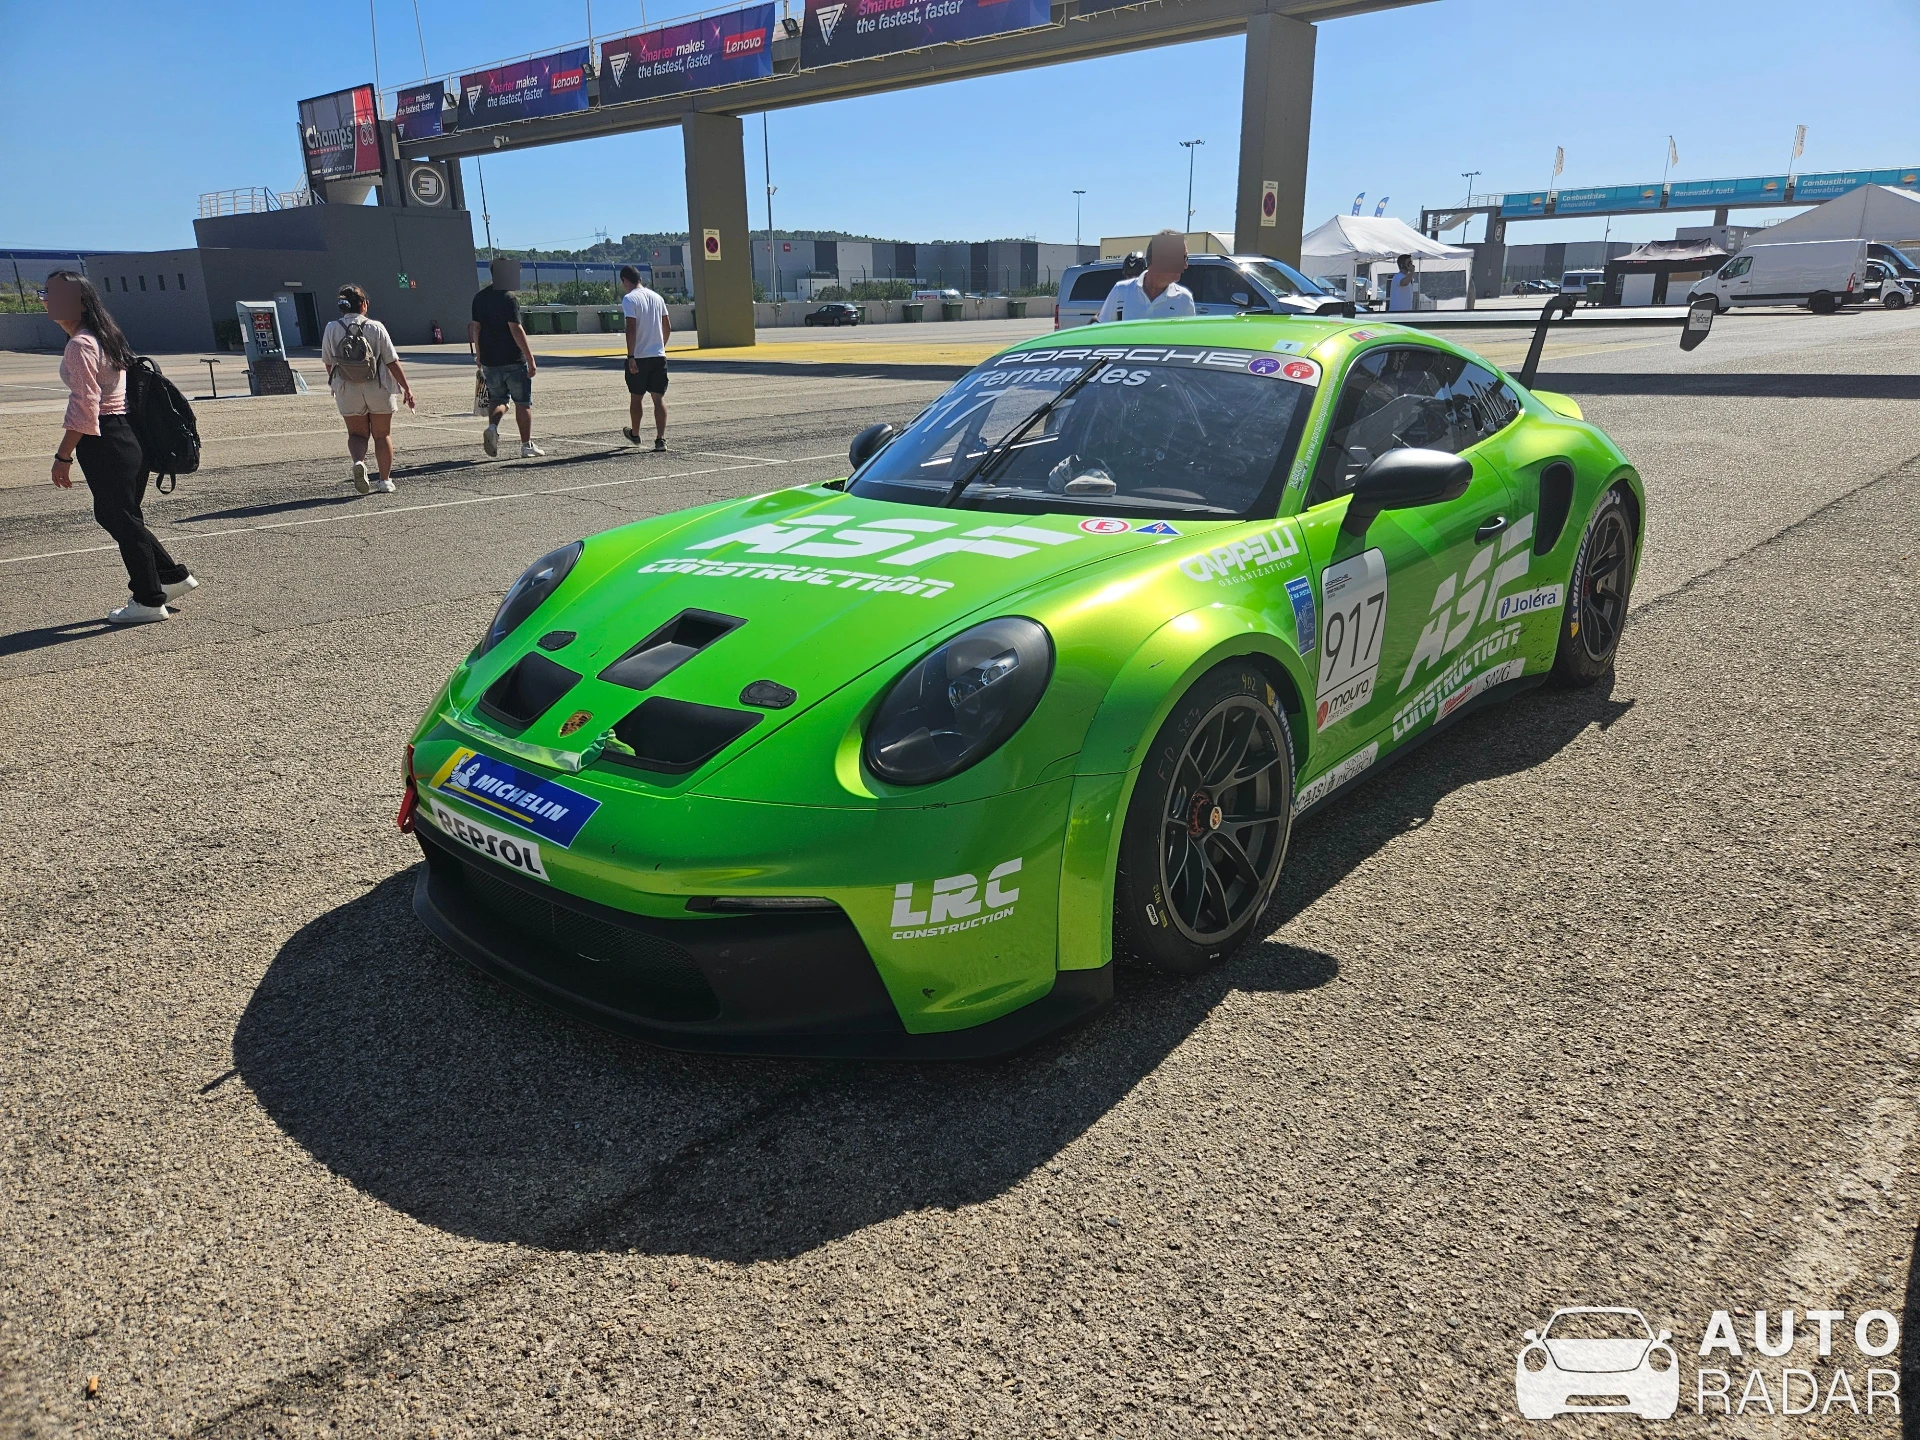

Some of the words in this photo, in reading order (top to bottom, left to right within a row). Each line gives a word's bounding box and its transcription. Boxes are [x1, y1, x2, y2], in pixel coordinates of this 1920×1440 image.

[856, 18, 875, 34] the
[878, 9, 922, 30] fastest,
[925, 0, 962, 19] faster
[640, 48, 674, 63] Smarter
[675, 40, 705, 57] makes
[725, 36, 762, 54] Lenovo
[638, 66, 652, 79] the
[654, 59, 685, 76] fastest,
[686, 53, 713, 69] faster
[489, 82, 514, 94] Smarter
[515, 75, 538, 88] makes
[552, 75, 580, 89] Lenovo
[487, 97, 498, 108] the
[499, 93, 523, 106] fastest,
[524, 88, 544, 101] faster
[306, 125, 353, 150] Champs
[418, 177, 439, 196] 3
[1675, 188, 1714, 197] Renewable
[1715, 187, 1735, 195] fuels
[1800, 186, 1844, 195] renovables
[1802, 177, 1857, 187] Combustibles
[1562, 192, 1606, 201] Combustibles
[994, 348, 1252, 368] PORSCHE
[1256, 366, 1267, 374] A
[1292, 370, 1301, 378] B
[1178, 526, 1299, 582] CAPPELLI
[1572, 525, 1593, 607] MICHELIN
[637, 558, 955, 599] CONSTRUCTION
[1218, 559, 1293, 587] ORGANIZATION
[1325, 590, 1385, 682] 917
[1392, 621, 1522, 742] CONSTRUCTION
[473, 773, 569, 822] MICHELIN
[437, 807, 541, 875] REPSOL
[890, 857, 1023, 927] LRC
[892, 906, 1014, 940] CONSTRUCTION
